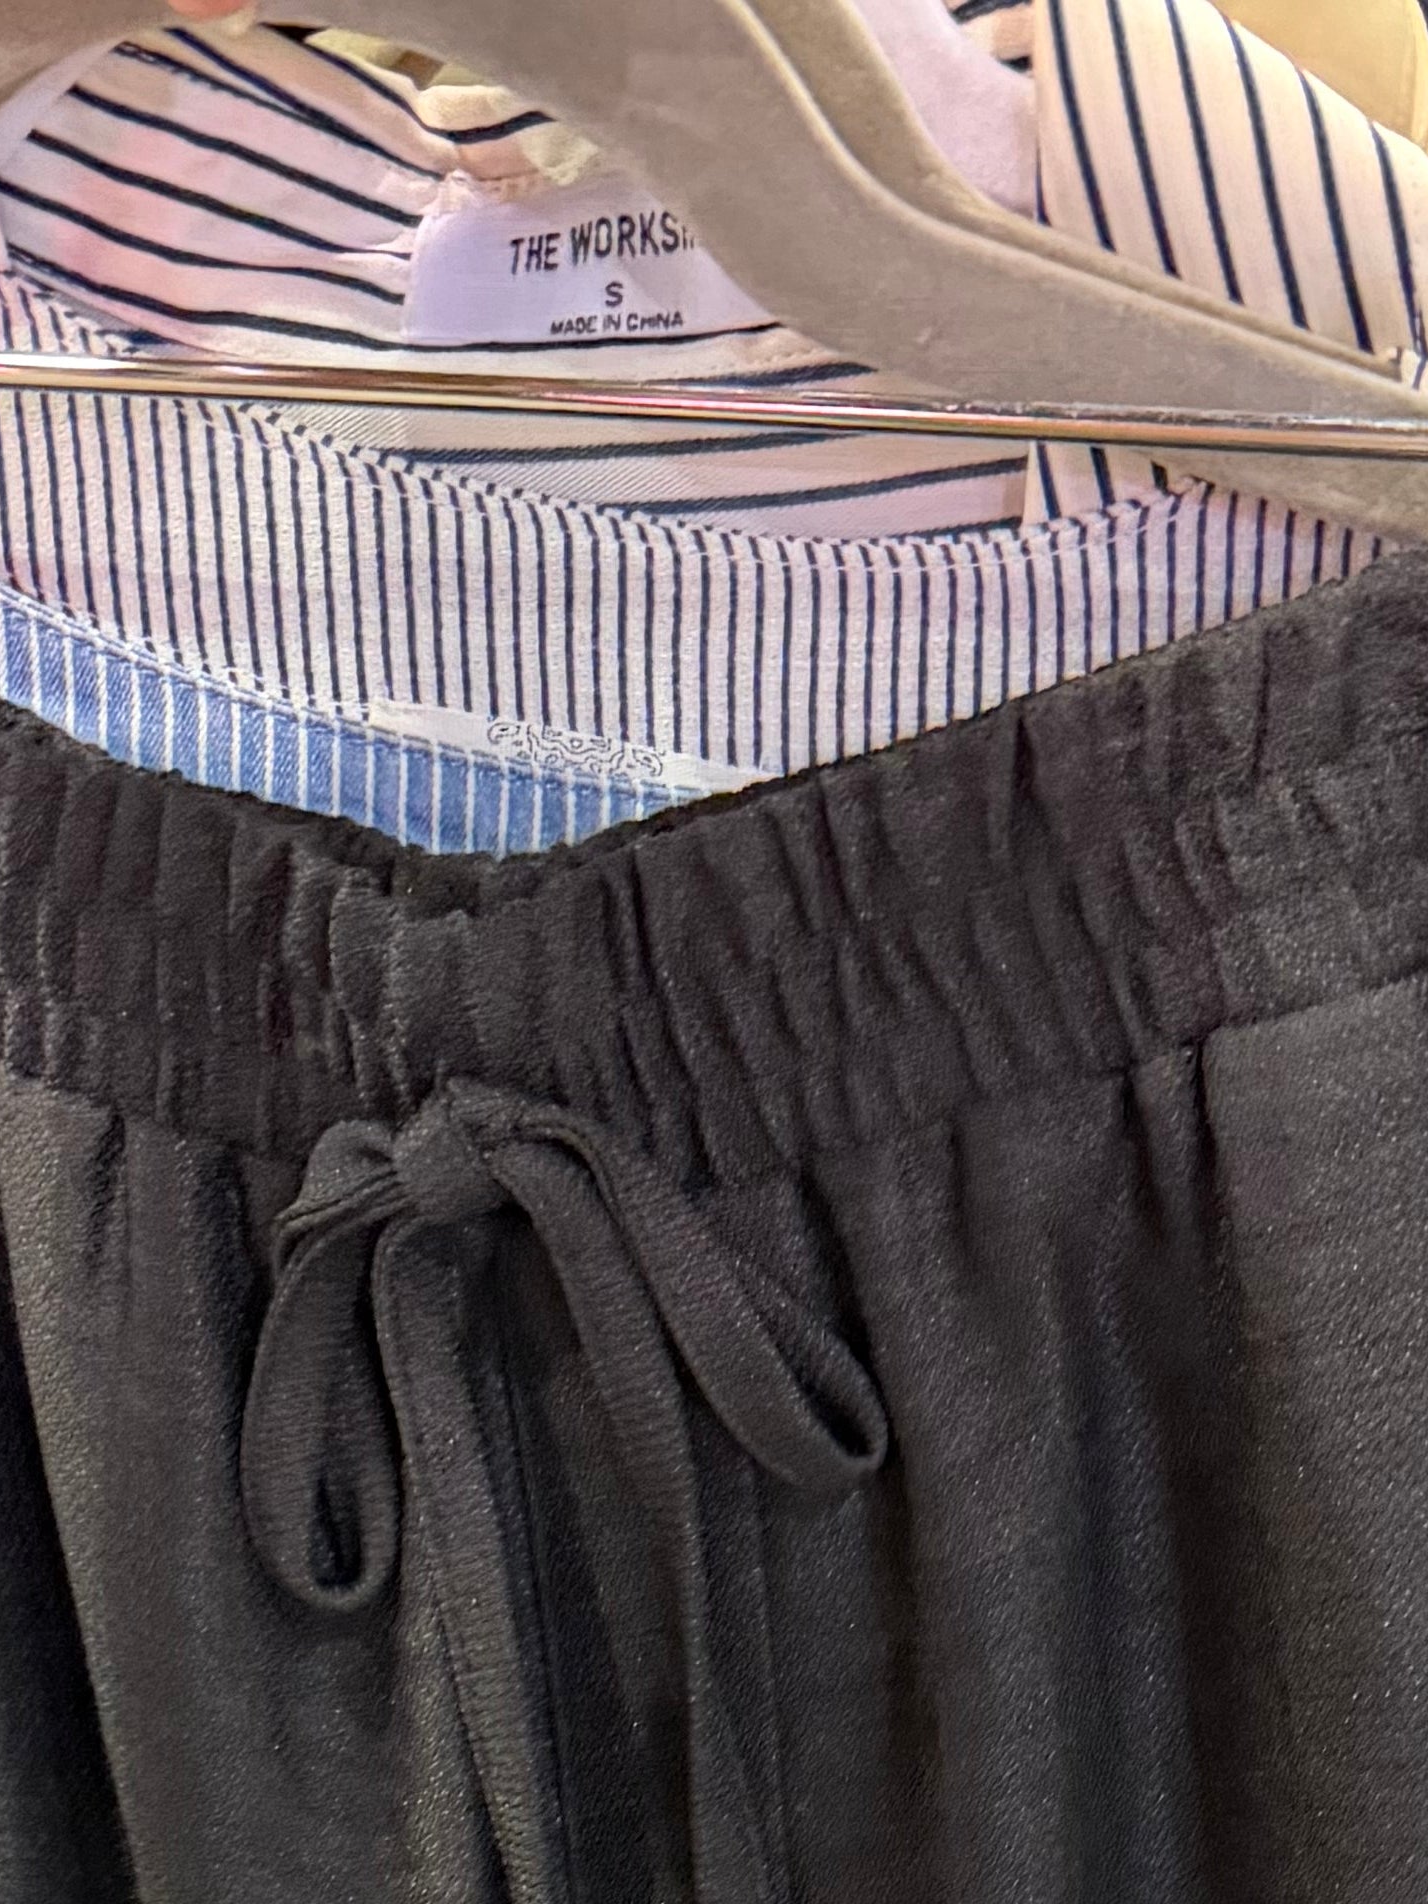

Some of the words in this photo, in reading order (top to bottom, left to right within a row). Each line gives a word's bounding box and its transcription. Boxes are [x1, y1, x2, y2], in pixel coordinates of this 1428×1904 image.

[510, 232, 561, 275] THE
[605, 281, 624, 307] S
[550, 315, 598, 335] MADE
[602, 314, 622, 332] IN
[626, 311, 684, 332] CHINA
